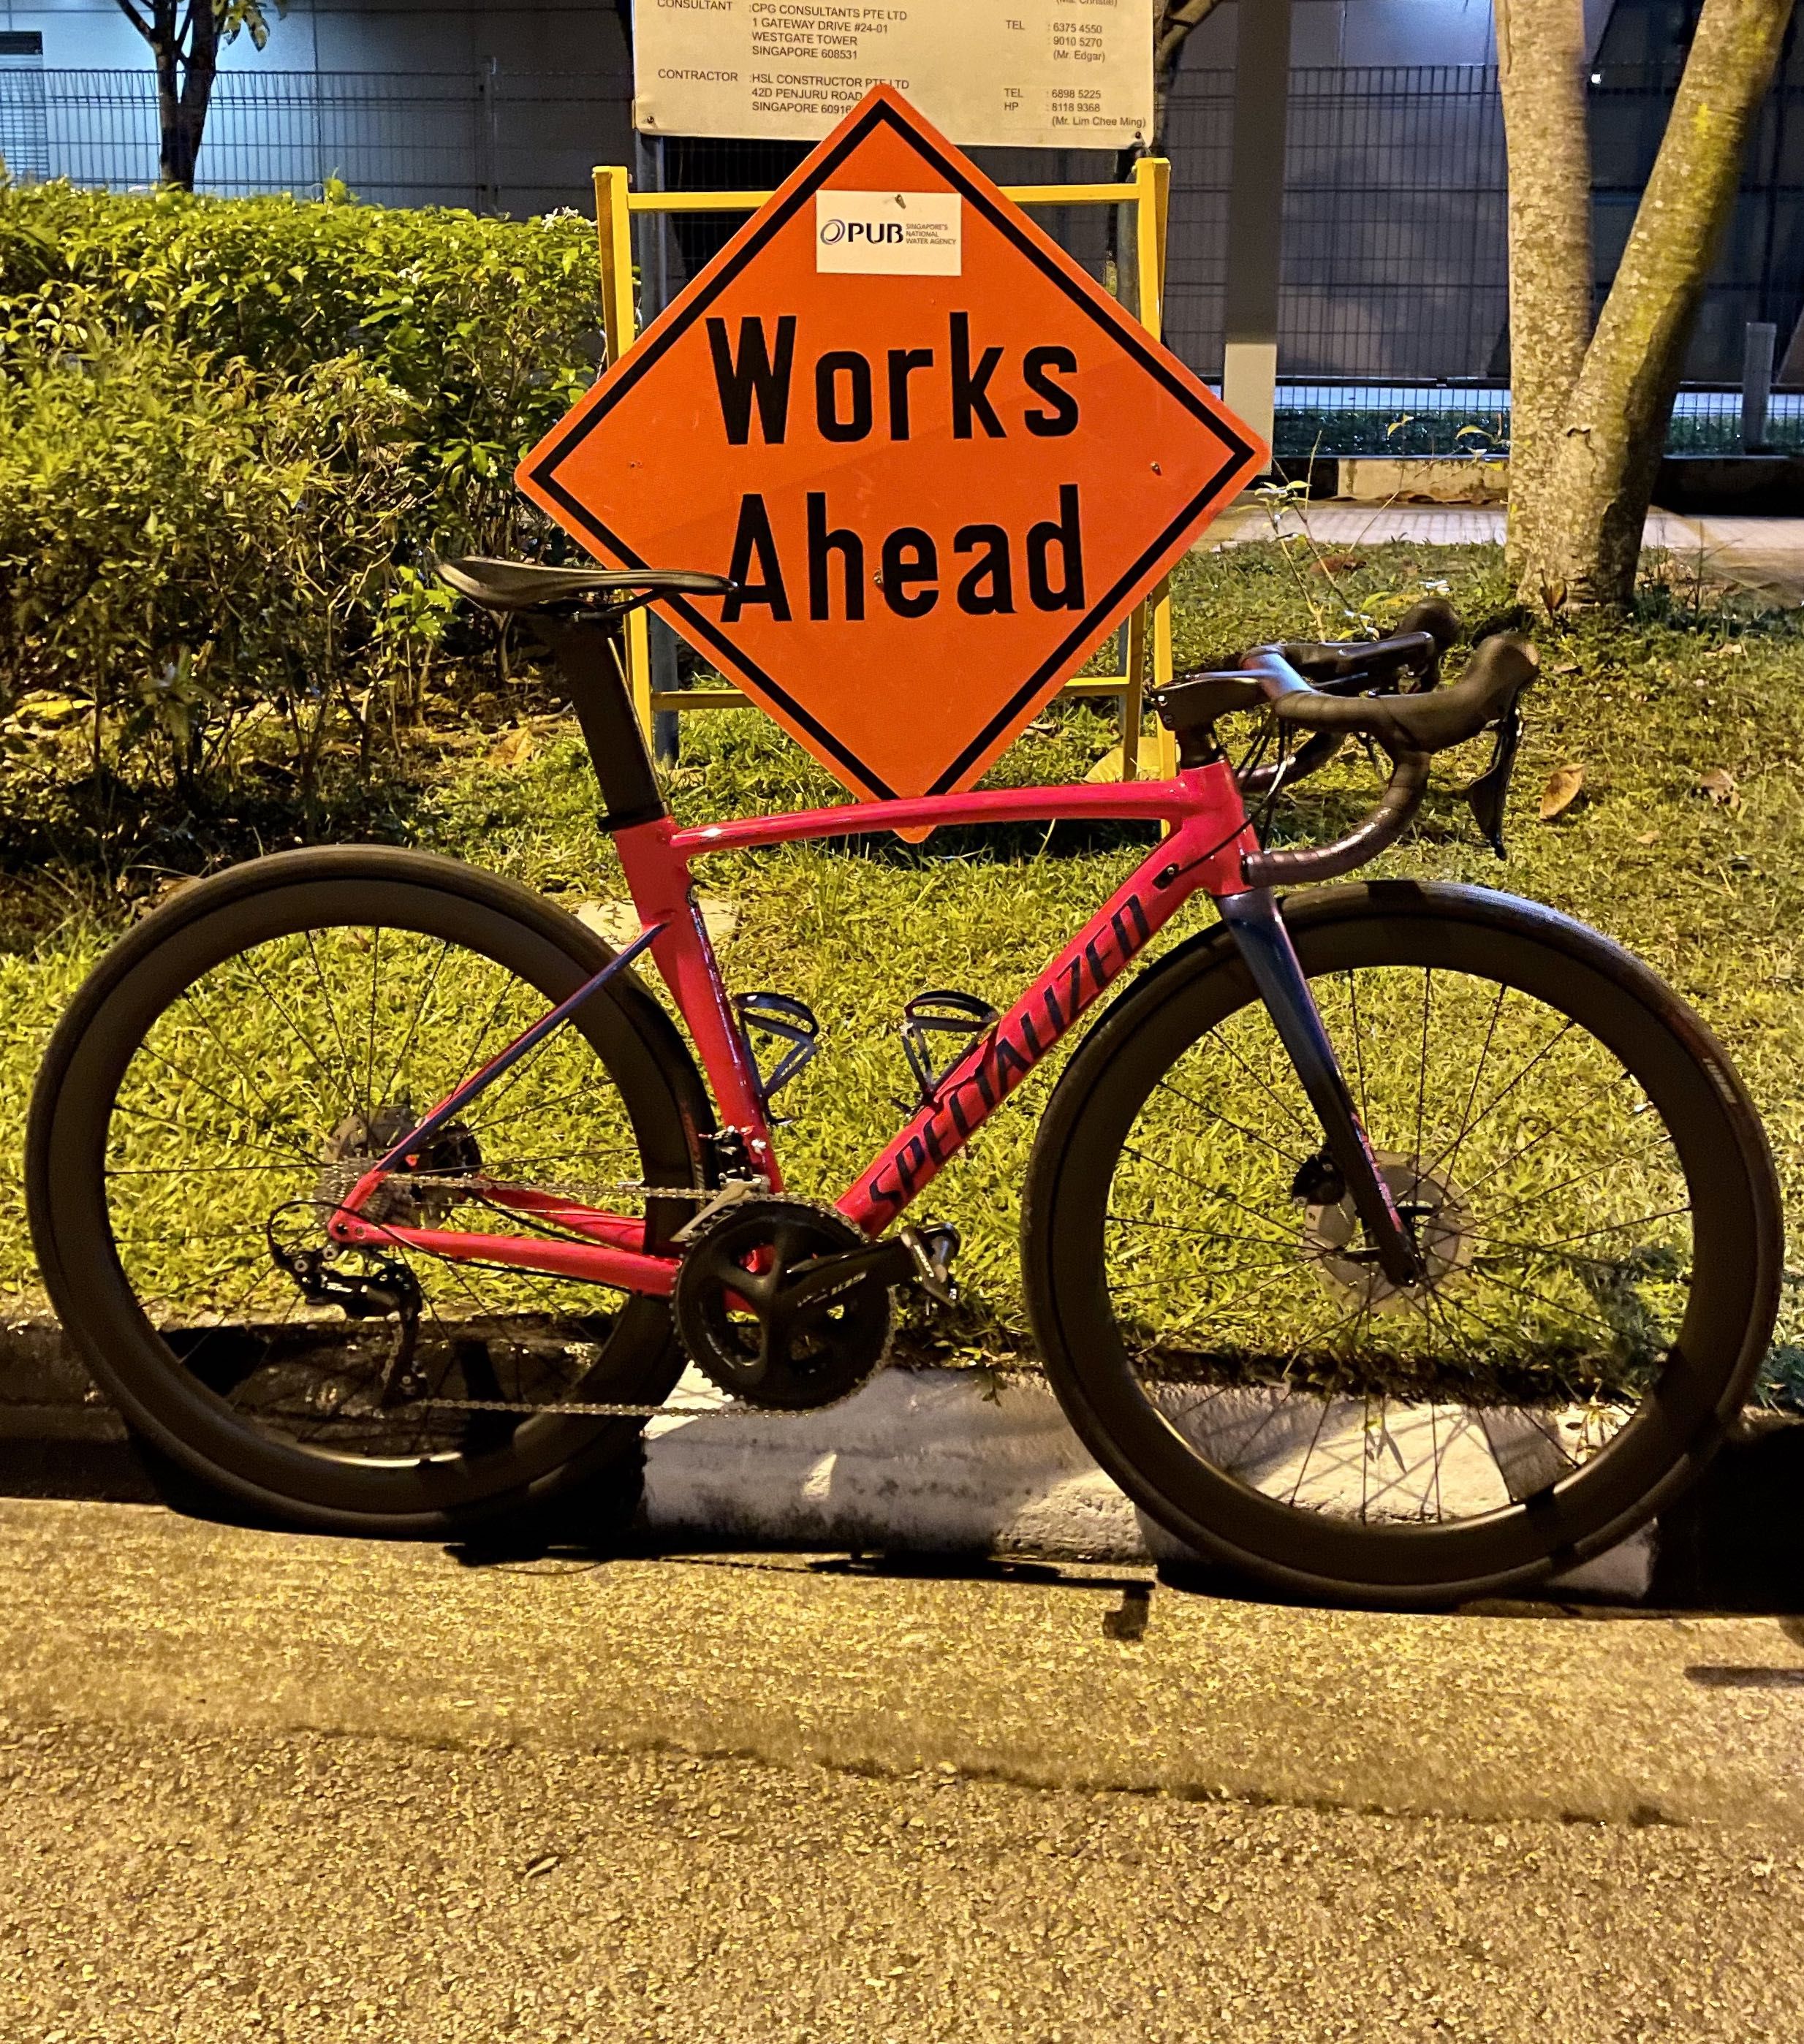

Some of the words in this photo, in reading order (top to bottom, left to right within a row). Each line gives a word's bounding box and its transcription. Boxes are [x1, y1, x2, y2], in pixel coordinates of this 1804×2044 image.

[658, 0, 732, 10] CONSULTANT
[779, 4, 860, 18] CONSULTANTS
[863, 10, 884, 19] PTE
[887, 10, 907, 20] LTD
[753, 18, 757, 27] 1
[761, 18, 815, 29] GATEWAY
[818, 20, 851, 31] DRIVE
[854, 23, 887, 33] #24-01
[1006, 20, 1025, 30] TEL
[1053, 23, 1076, 33] 6375
[1079, 24, 1102, 34] 4550
[752, 31, 814, 44] WESTGATE
[817, 35, 857, 46] TOWER
[1053, 36, 1076, 46] 9010
[1079, 37, 1102, 48] 5270
[752, 45, 818, 58] SINGAPORE
[822, 48, 857, 59] 608531
[1074, 50, 1105, 63] Edgar)
[658, 69, 738, 82] CONTRACTOR
[776, 75, 863, 88] CONSTRUCTOR
[751, 88, 772, 97] 42D
[776, 88, 827, 99] PENJURU
[831, 91, 863, 101] ROAD
[1004, 88, 1023, 98] TEL
[1052, 89, 1075, 98] 6898
[1078, 89, 1101, 99] 5225
[752, 102, 818, 113] SINGAPORE
[822, 105, 854, 115] 60916
[1004, 102, 1019, 111] HP
[1052, 102, 1074, 112] 8118
[1077, 103, 1100, 113] 9368
[1073, 116, 1089, 126] Lim
[1092, 117, 1117, 126] Chee
[1120, 117, 1146, 129] Ming)
[848, 223, 903, 244] PUB
[930, 238, 957, 246] AGENCY
[705, 311, 1079, 445] Works
[720, 484, 1085, 623] Ahead
[869, 894, 1150, 1210] SPECIALIZED
